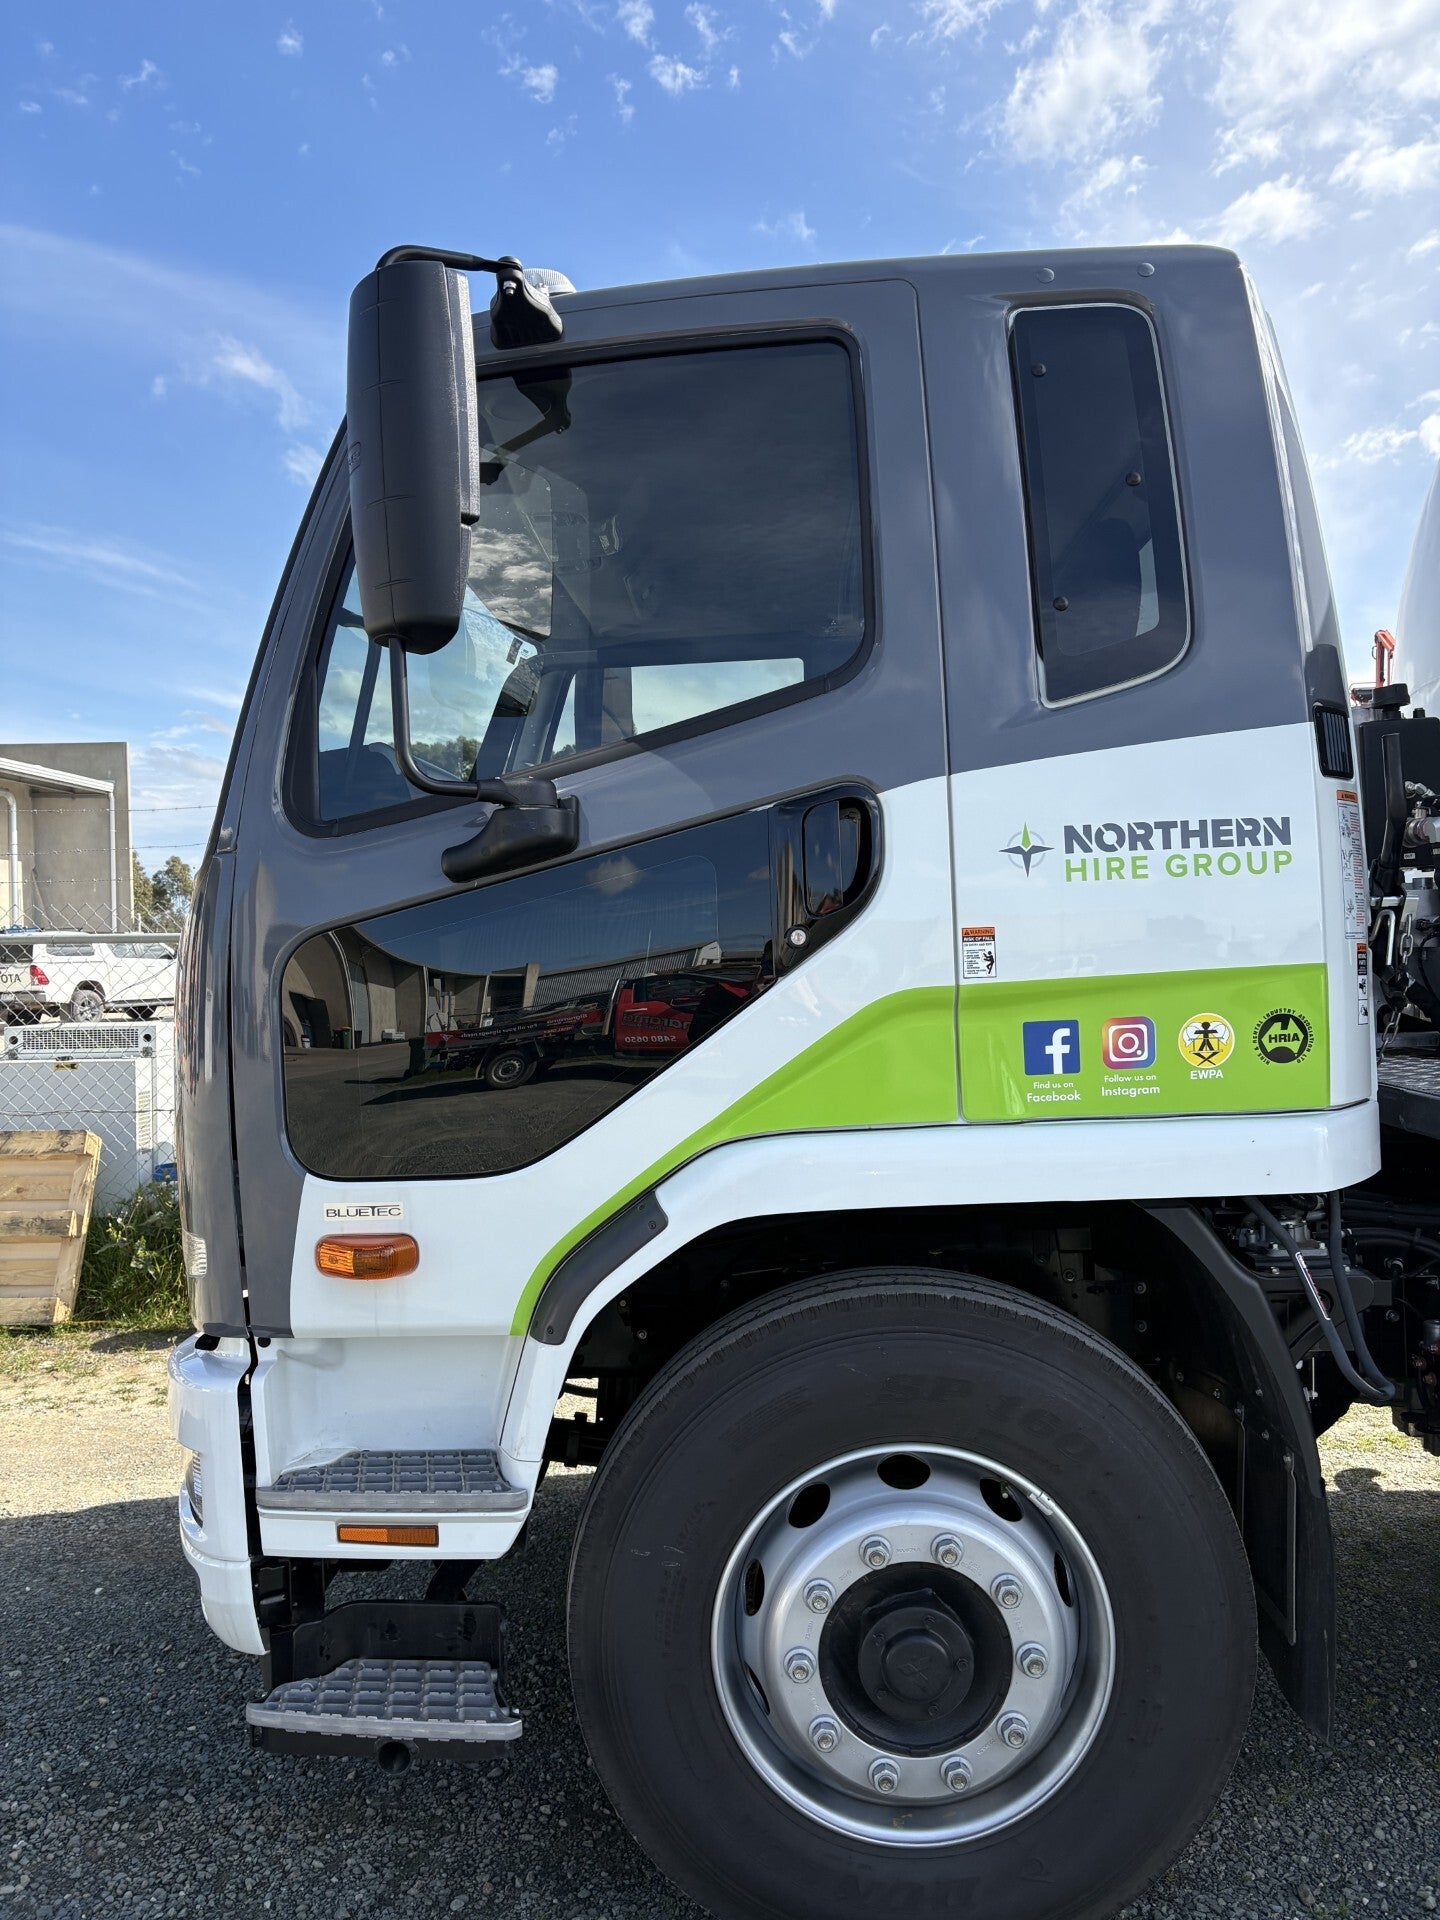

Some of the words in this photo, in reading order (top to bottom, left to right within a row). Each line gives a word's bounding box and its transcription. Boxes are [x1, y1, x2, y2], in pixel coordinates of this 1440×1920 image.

[1064, 816, 1292, 854] NORTHERN
[1065, 855, 1149, 882] HIRE
[1165, 850, 1292, 878] GROUP
[0, 973, 21, 983] OTA
[1268, 1032, 1301, 1043] HRIA
[1104, 1074, 1132, 1082] Follow
[1190, 1069, 1224, 1080] EWPA
[1033, 1081, 1050, 1089] Find
[1026, 1090, 1081, 1102] Facebook
[1101, 1086, 1160, 1097] Instagram
